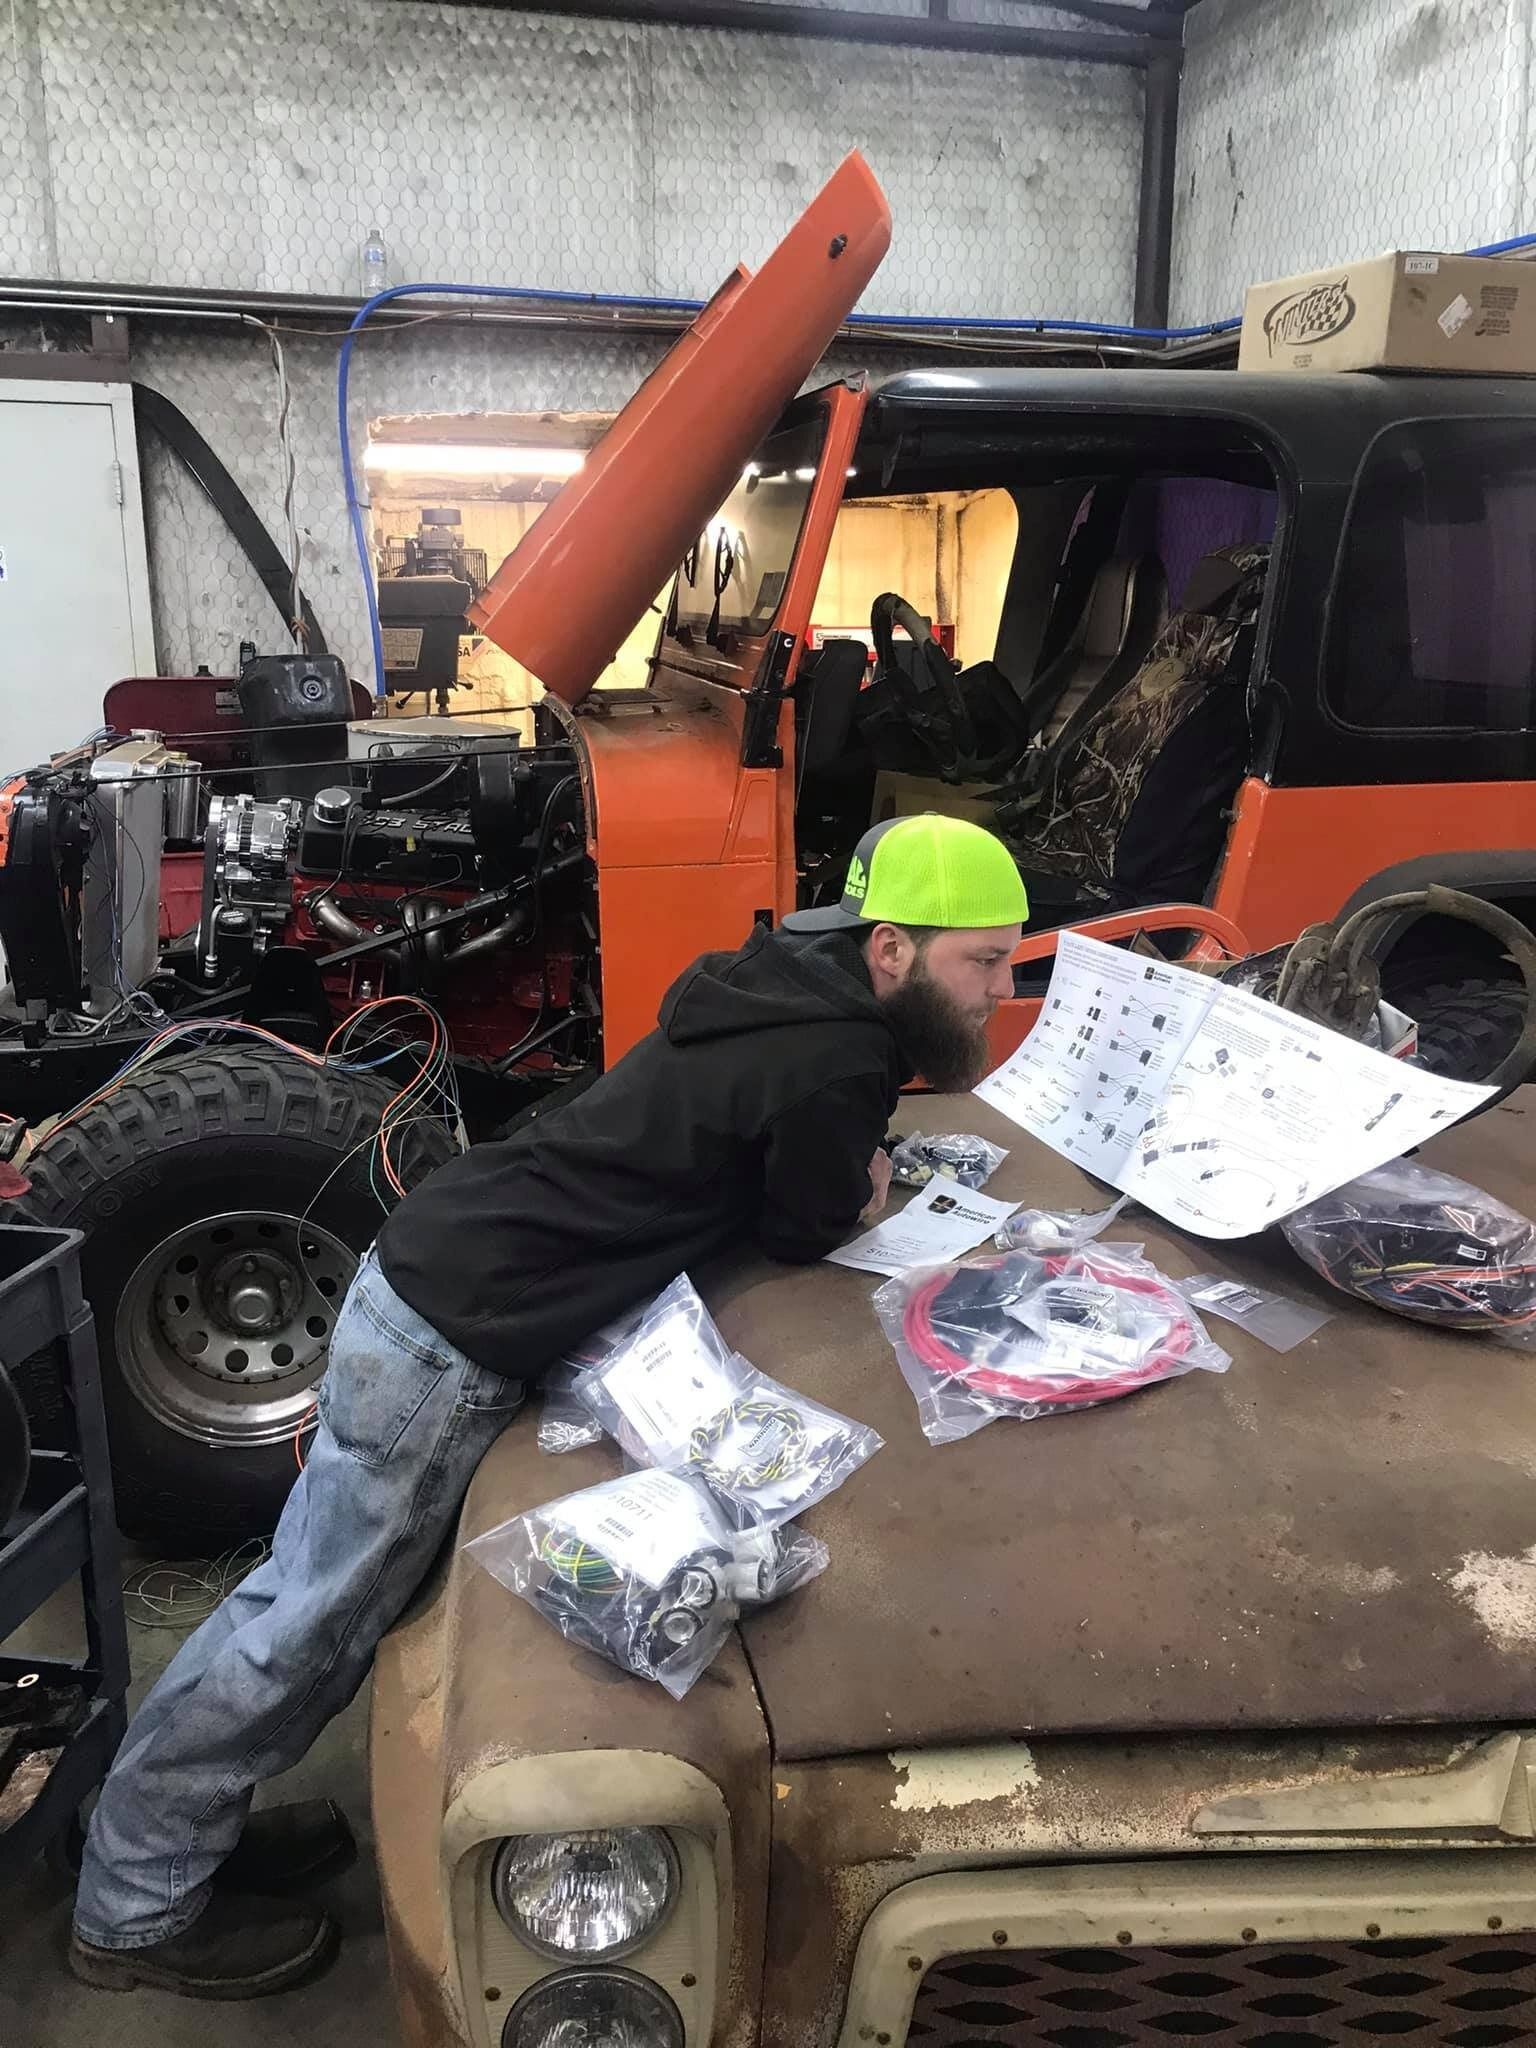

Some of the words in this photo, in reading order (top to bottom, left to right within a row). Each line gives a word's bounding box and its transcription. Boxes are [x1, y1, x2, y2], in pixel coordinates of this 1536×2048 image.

[951, 1210, 991, 1225] Autowire
[954, 1204, 997, 1221] American
[748, 1418, 776, 1449] WARNING
